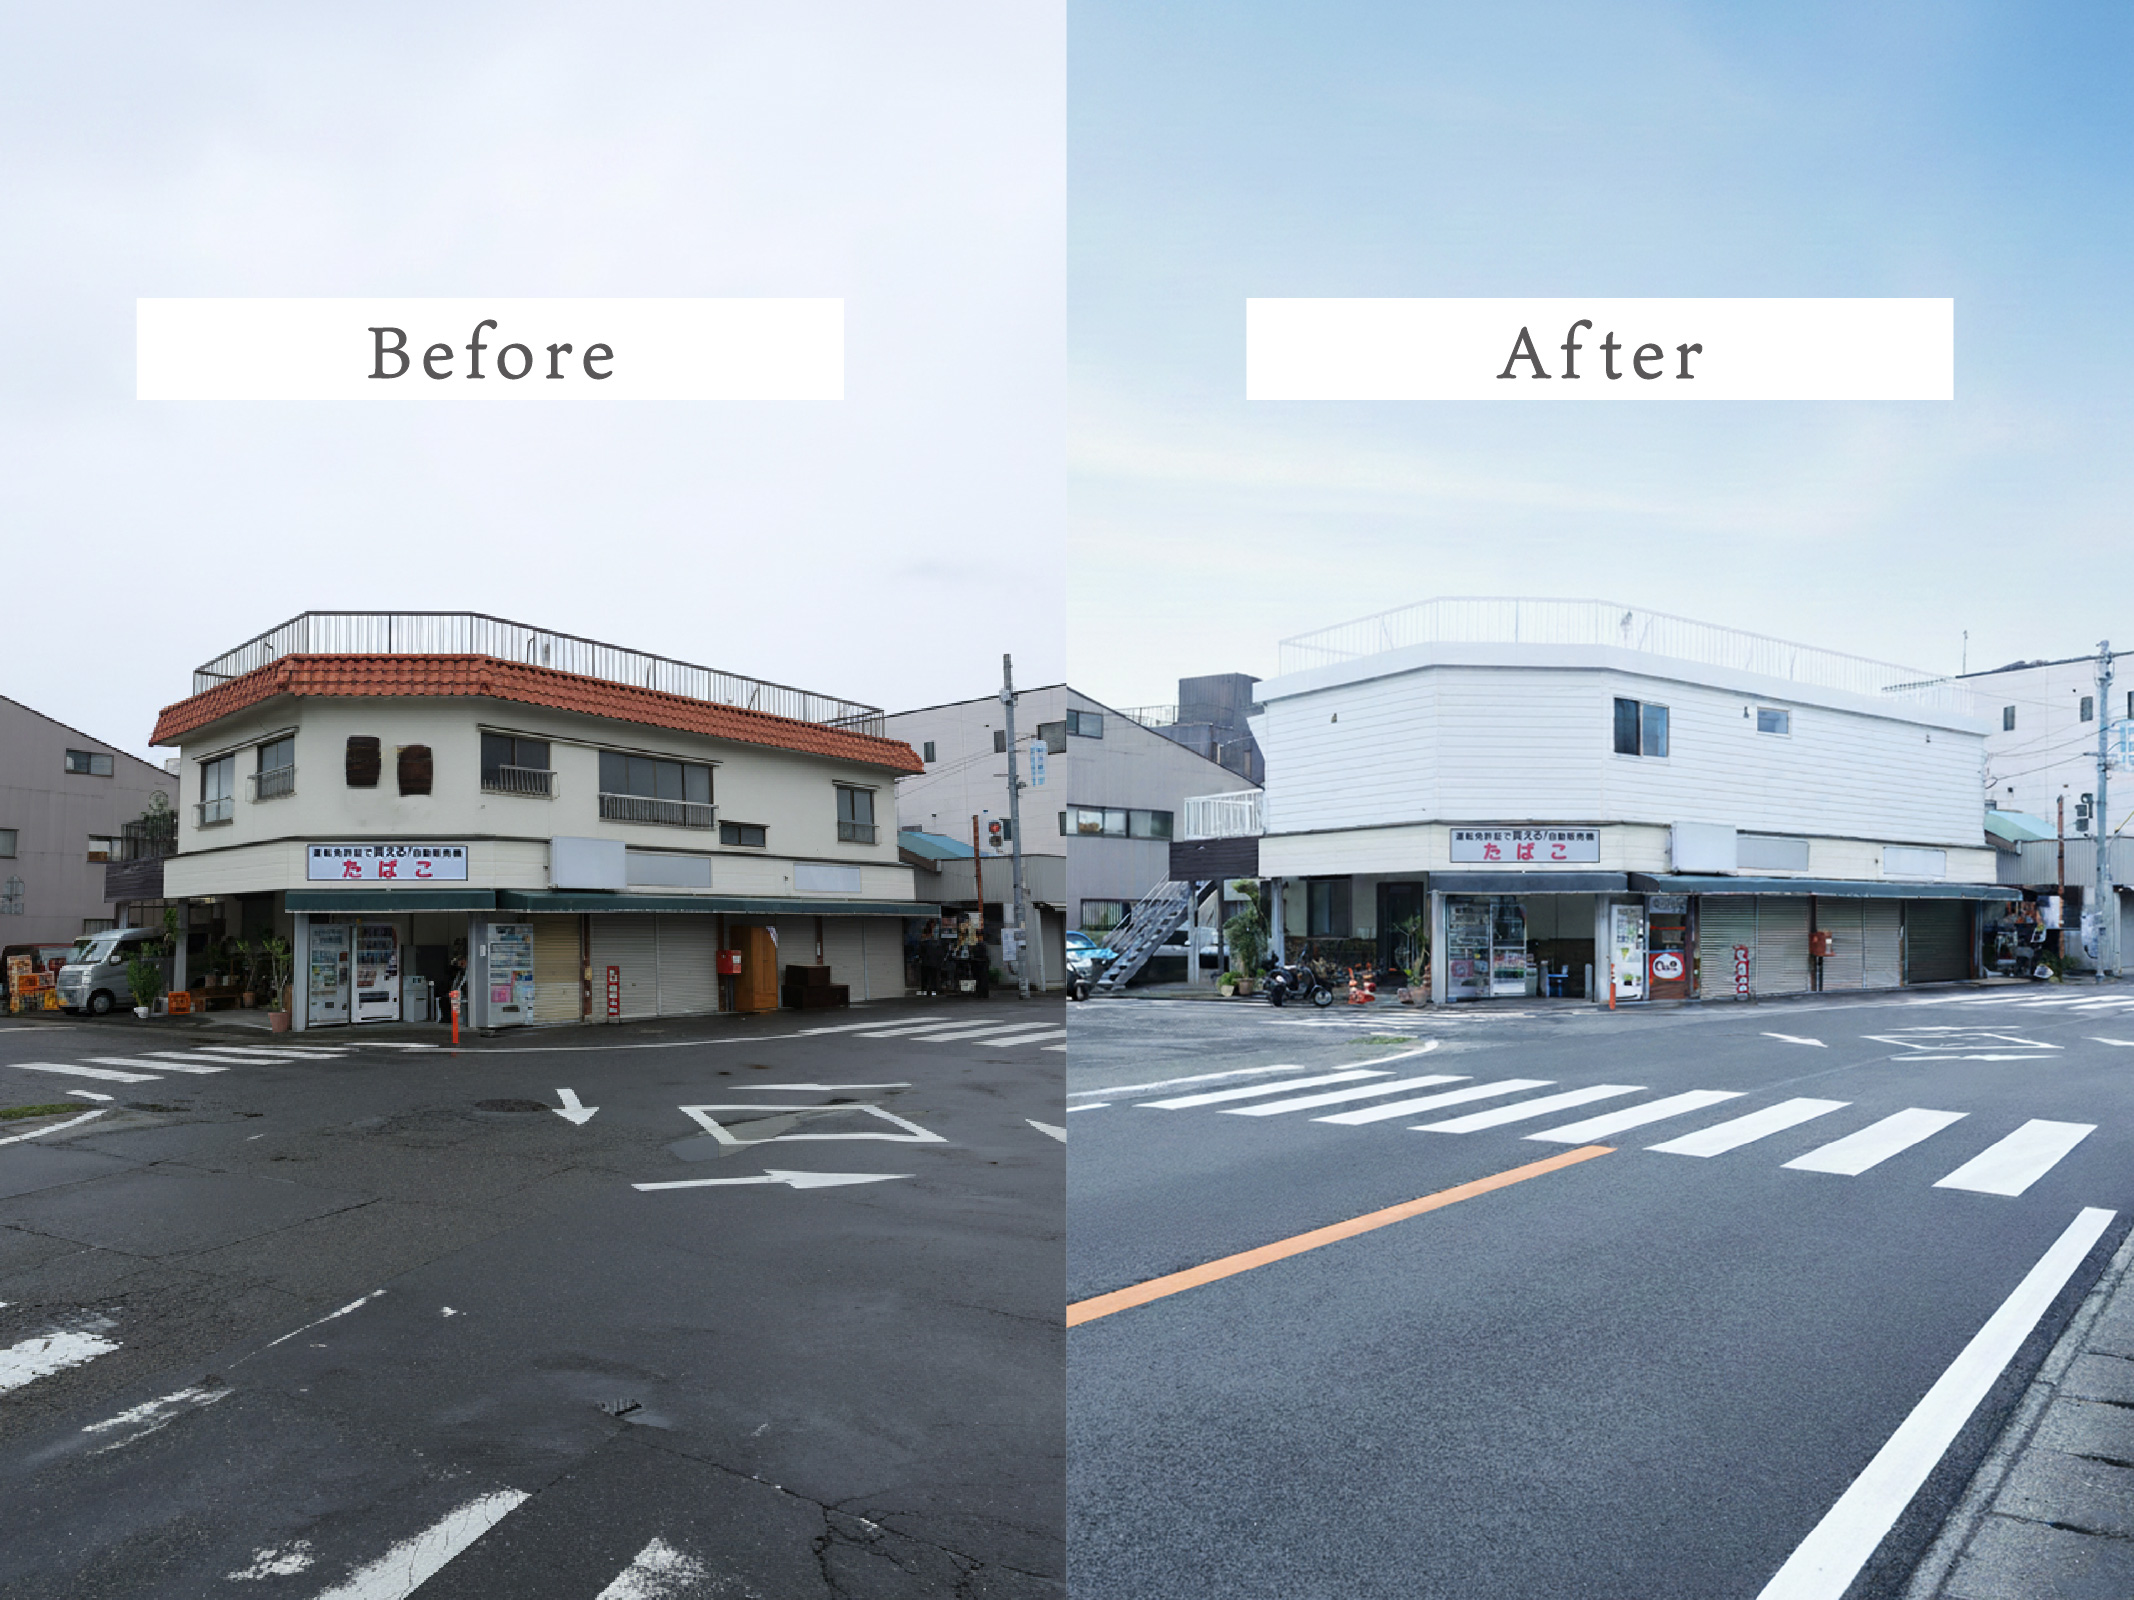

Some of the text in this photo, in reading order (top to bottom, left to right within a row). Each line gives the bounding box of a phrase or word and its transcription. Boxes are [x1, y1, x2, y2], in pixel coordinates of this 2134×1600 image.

[1484, 843, 1568, 861] たばこ
[344, 859, 432, 878] たばこ
